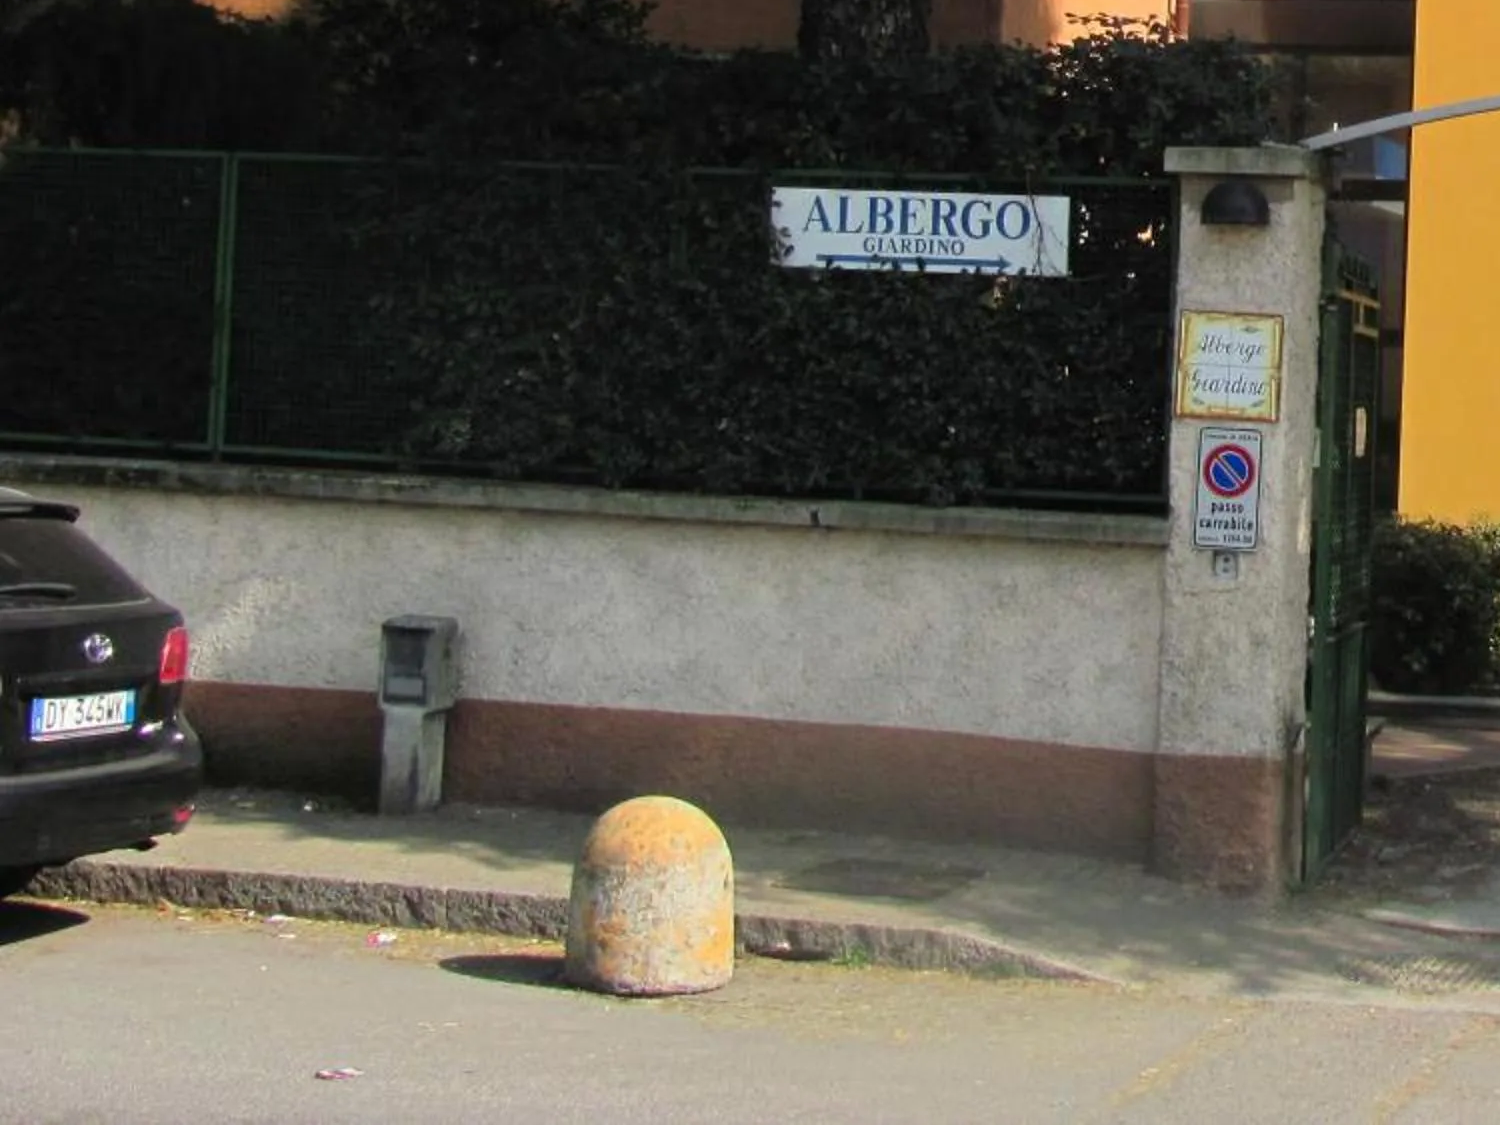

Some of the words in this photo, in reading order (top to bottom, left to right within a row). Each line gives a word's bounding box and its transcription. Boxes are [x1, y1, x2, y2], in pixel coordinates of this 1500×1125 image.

[803, 194, 1031, 240] ALBERGO
[863, 236, 965, 256] GIARDINO
[1211, 501, 1244, 516] passo
